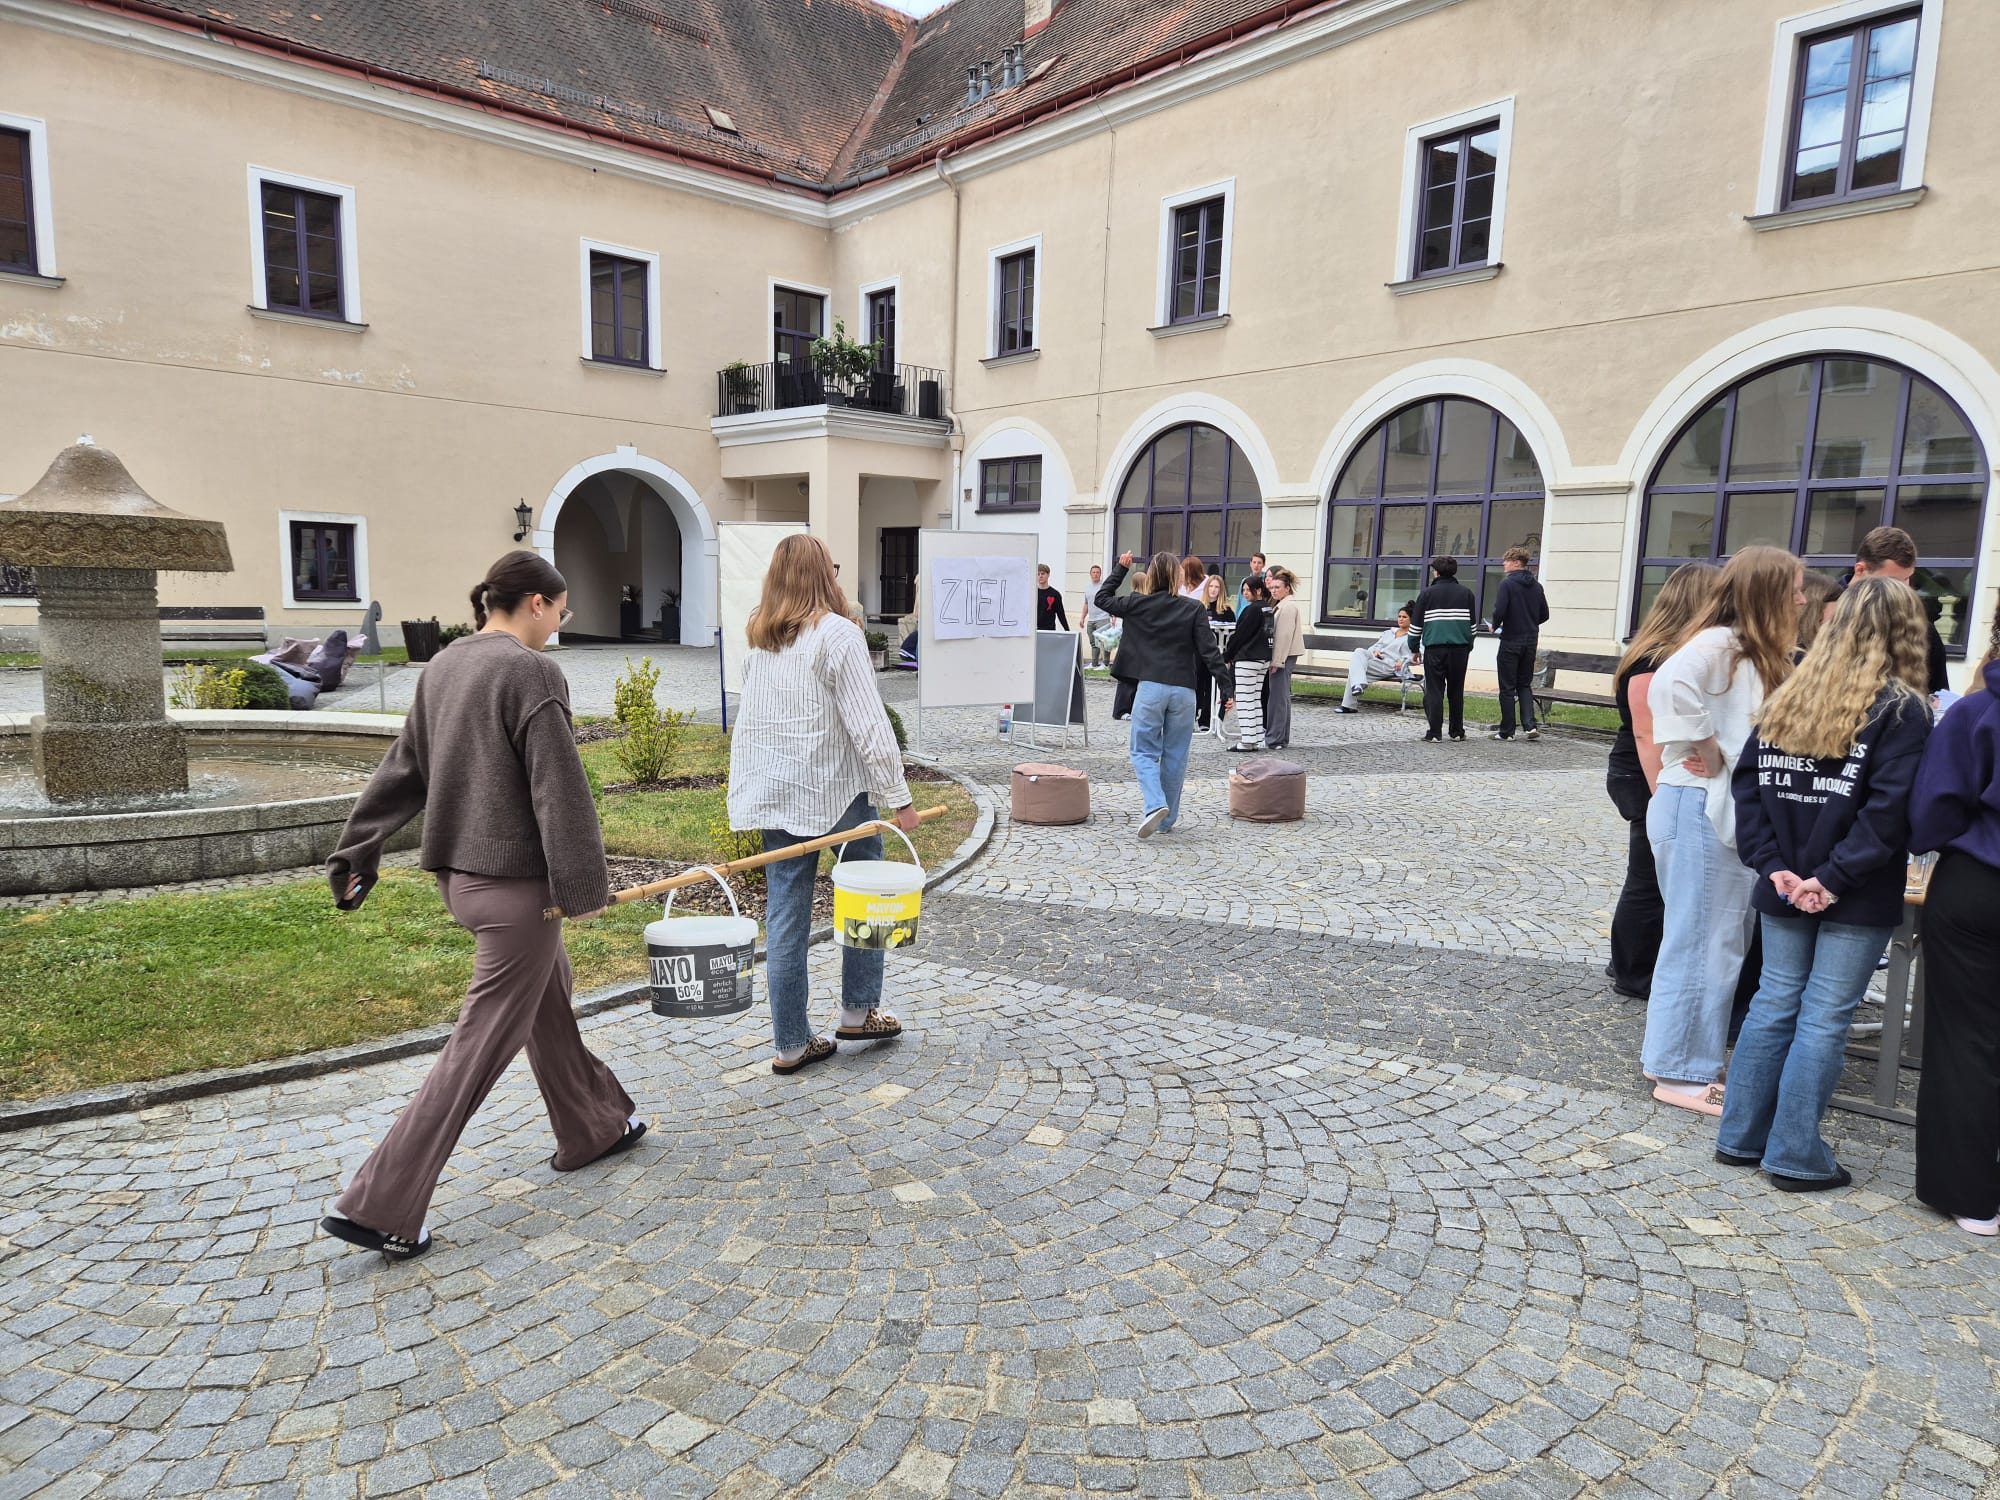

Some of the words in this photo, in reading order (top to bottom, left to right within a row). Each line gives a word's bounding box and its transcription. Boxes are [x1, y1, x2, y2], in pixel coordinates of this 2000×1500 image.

[940, 579, 1018, 626] ZIEL
[1775, 772, 1792, 787] LA
[711, 956, 732, 969] MAYO
[649, 957, 692, 985] MAYO
[677, 984, 702, 998] 50%
[383, 1243, 410, 1253] adidas
